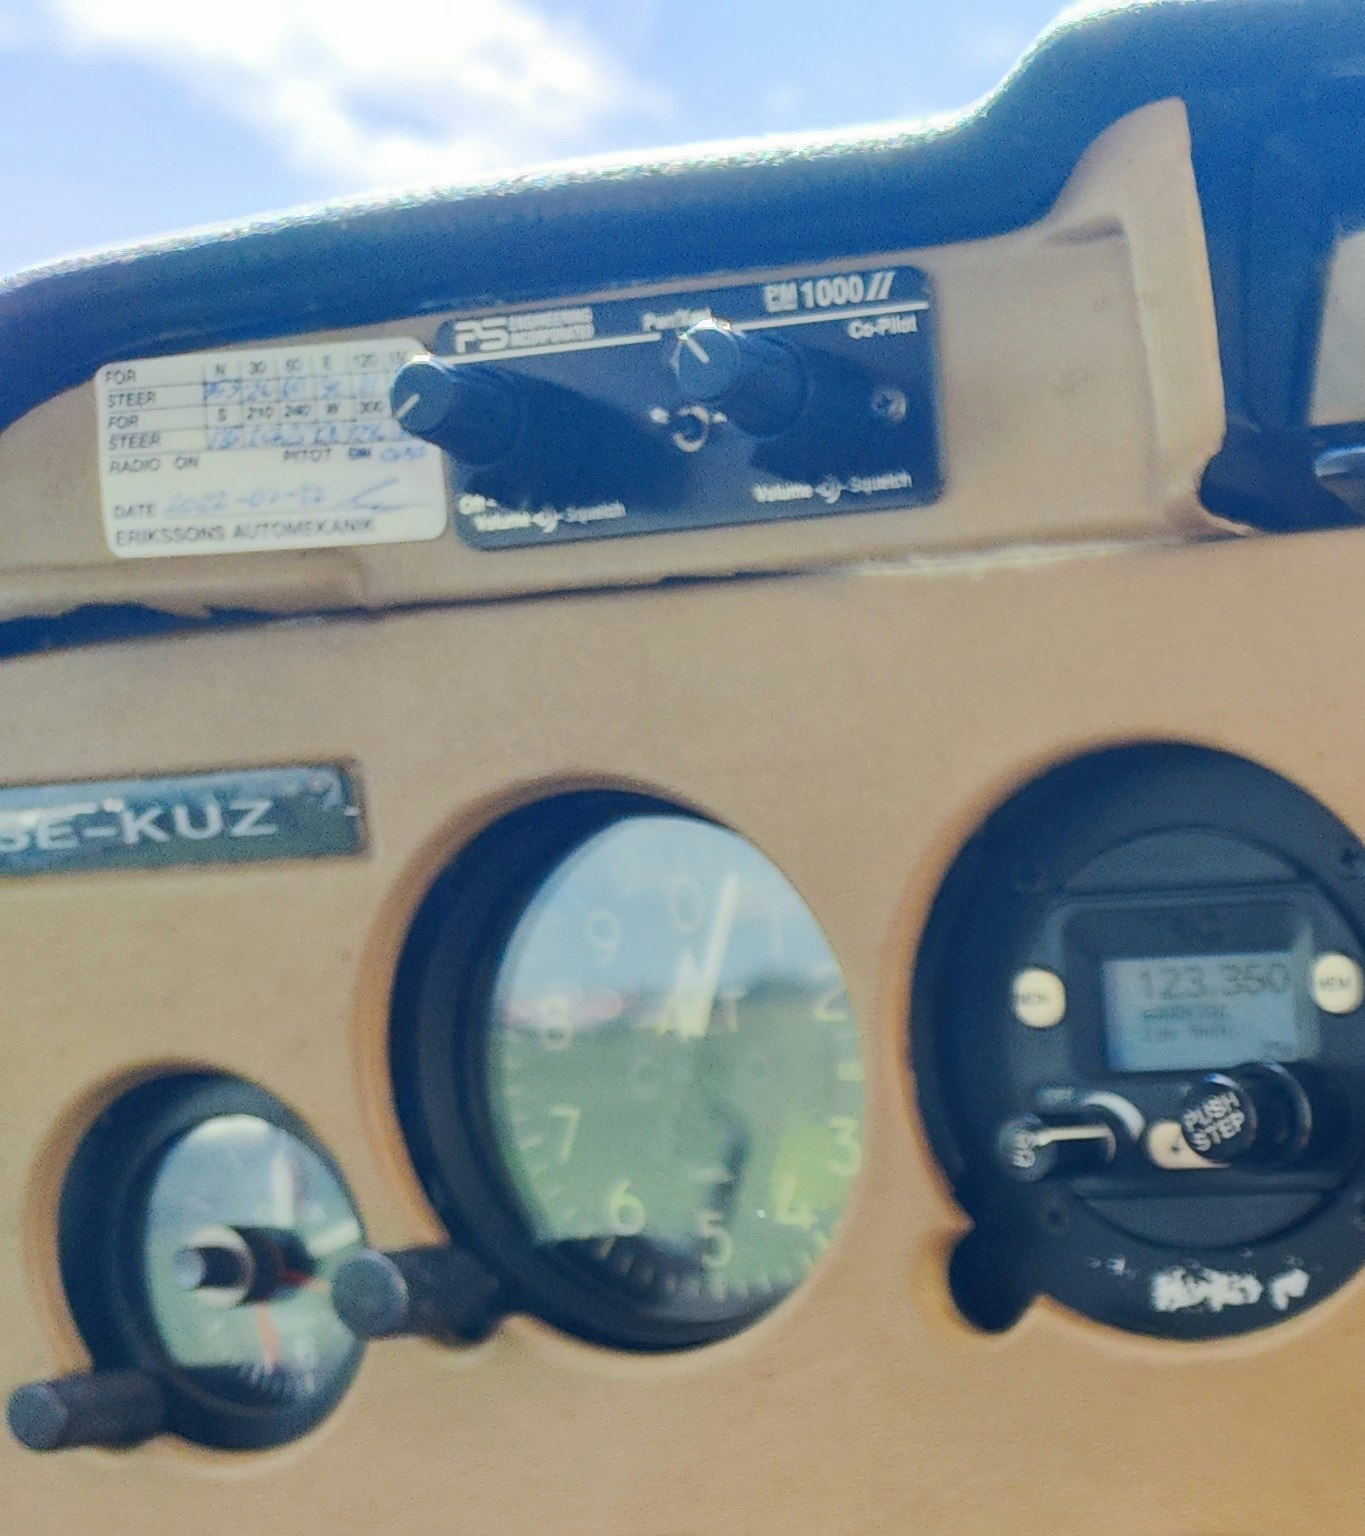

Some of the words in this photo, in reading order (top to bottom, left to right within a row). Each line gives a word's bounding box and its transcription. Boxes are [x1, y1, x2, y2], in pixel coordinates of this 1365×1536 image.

[800, 274, 866, 311] 1000
[453, 318, 511, 355] PS
[846, 314, 919, 341] Co-Pilot
[104, 369, 137, 387] FOR
[106, 391, 157, 409] STEER
[106, 413, 140, 431] FOR
[107, 433, 162, 451] STEER
[282, 447, 333, 464] PITOT
[109, 457, 162, 474] RADIO
[174, 454, 200, 470] ON
[111, 502, 157, 521] DATE
[115, 522, 227, 547] ERIKSSONS
[232, 516, 376, 541] AUTOMEKANIK
[1181, 1091, 1242, 1134] PUSH
[550, 1104, 583, 1164] 7
[828, 1115, 863, 1179] 3
[1188, 1108, 1247, 1152] STEP
[608, 1177, 648, 1238] 6
[773, 1173, 820, 1230] 4
[699, 1209, 734, 1268] 5
